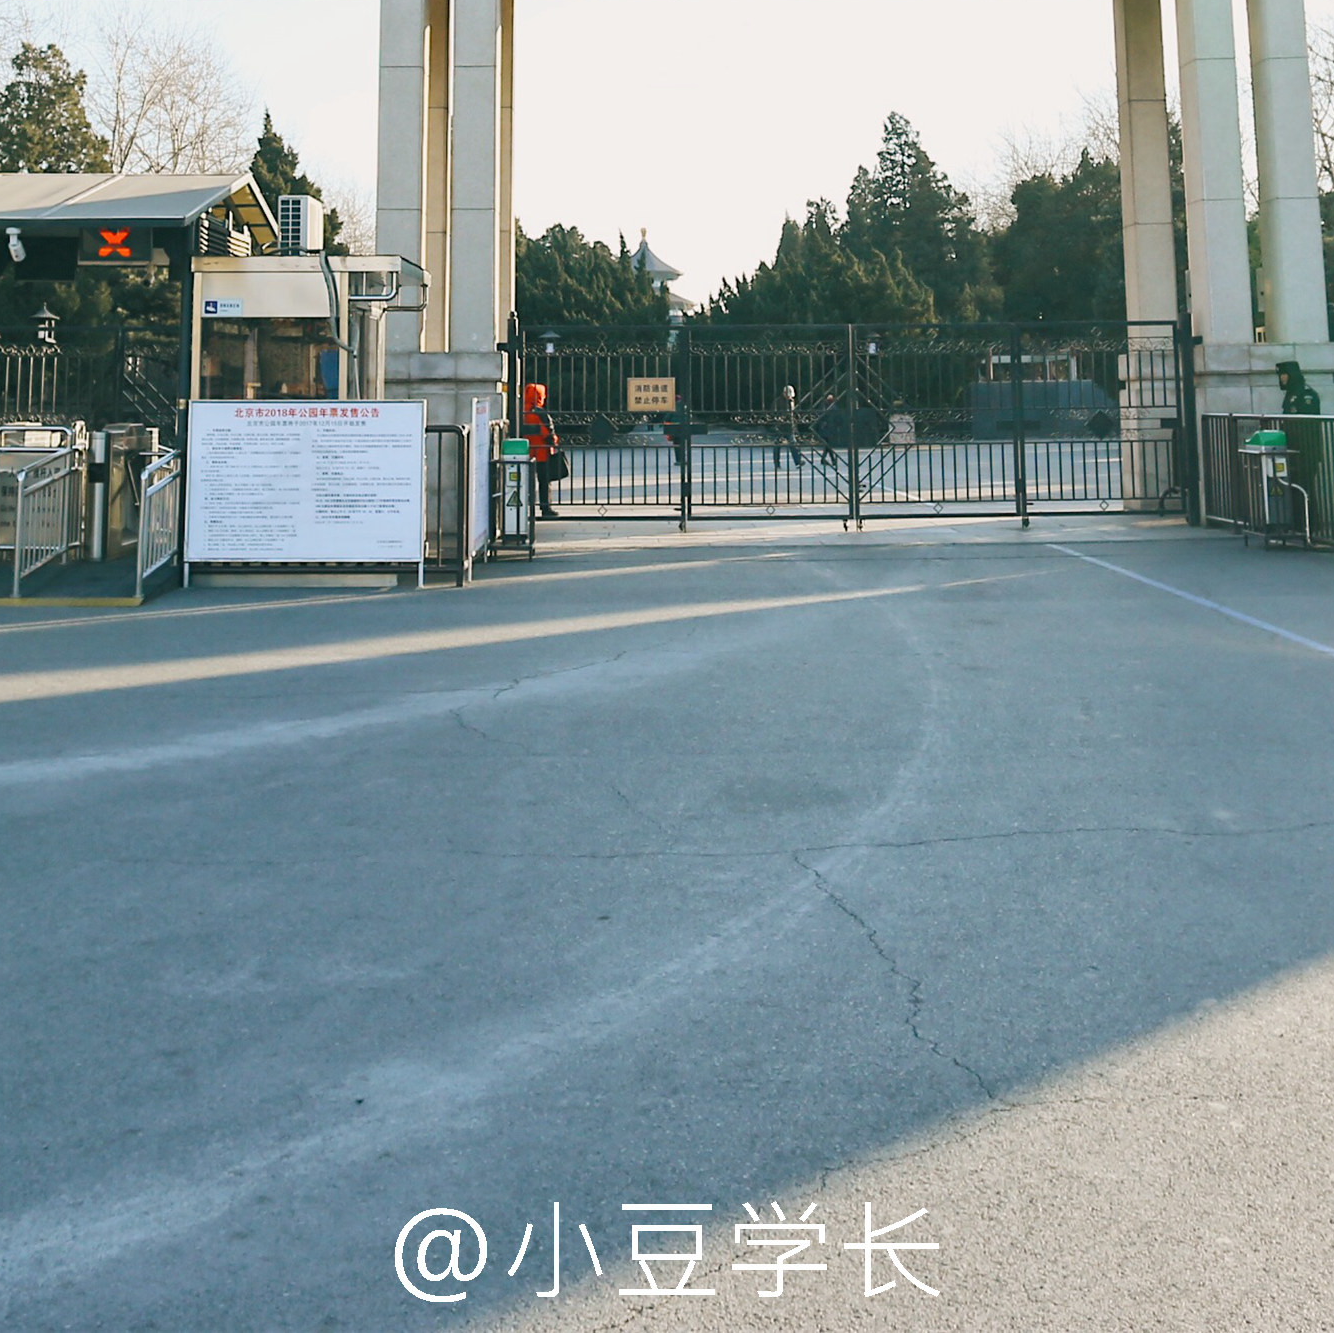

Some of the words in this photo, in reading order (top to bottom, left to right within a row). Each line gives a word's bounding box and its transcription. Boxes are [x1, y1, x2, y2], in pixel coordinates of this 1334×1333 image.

[634, 395, 669, 405] 禁止停车
[234, 407, 380, 418] 北京市2018年公园年票发售公告
